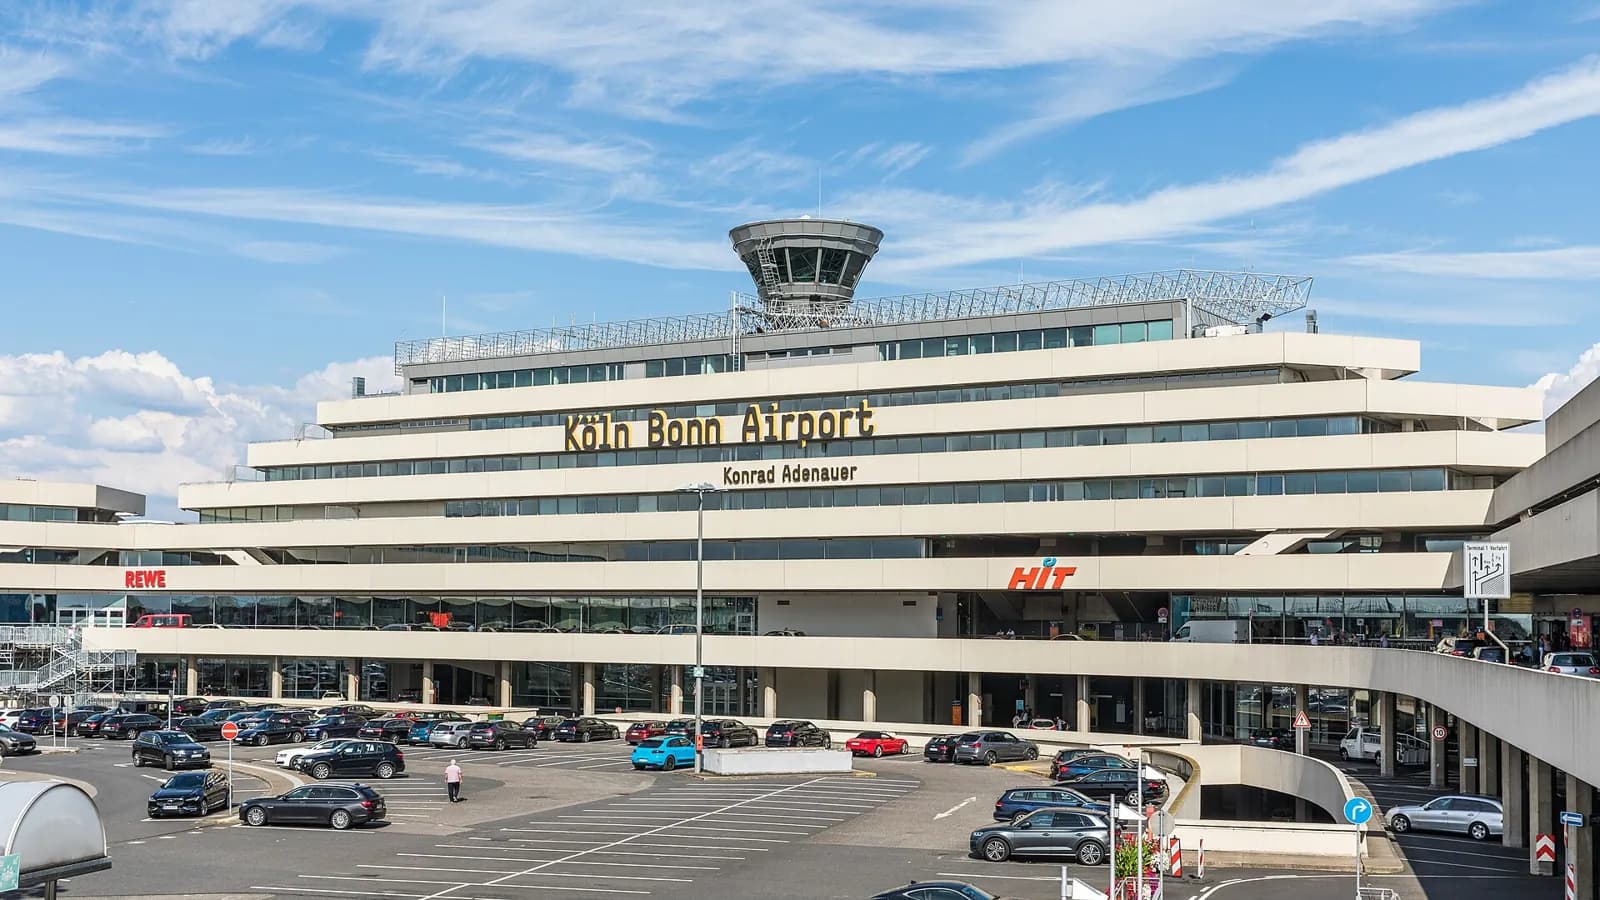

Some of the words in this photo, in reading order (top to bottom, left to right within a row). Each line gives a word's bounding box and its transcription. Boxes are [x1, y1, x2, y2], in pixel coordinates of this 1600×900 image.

[565, 413, 631, 450] Köln
[648, 409, 725, 448] Bonn
[742, 399, 877, 449] Airport
[723, 465, 775, 485] Konrad
[782, 463, 858, 484] Adenauer
[125, 570, 166, 588] REWE
[1008, 557, 1077, 590] HIT
